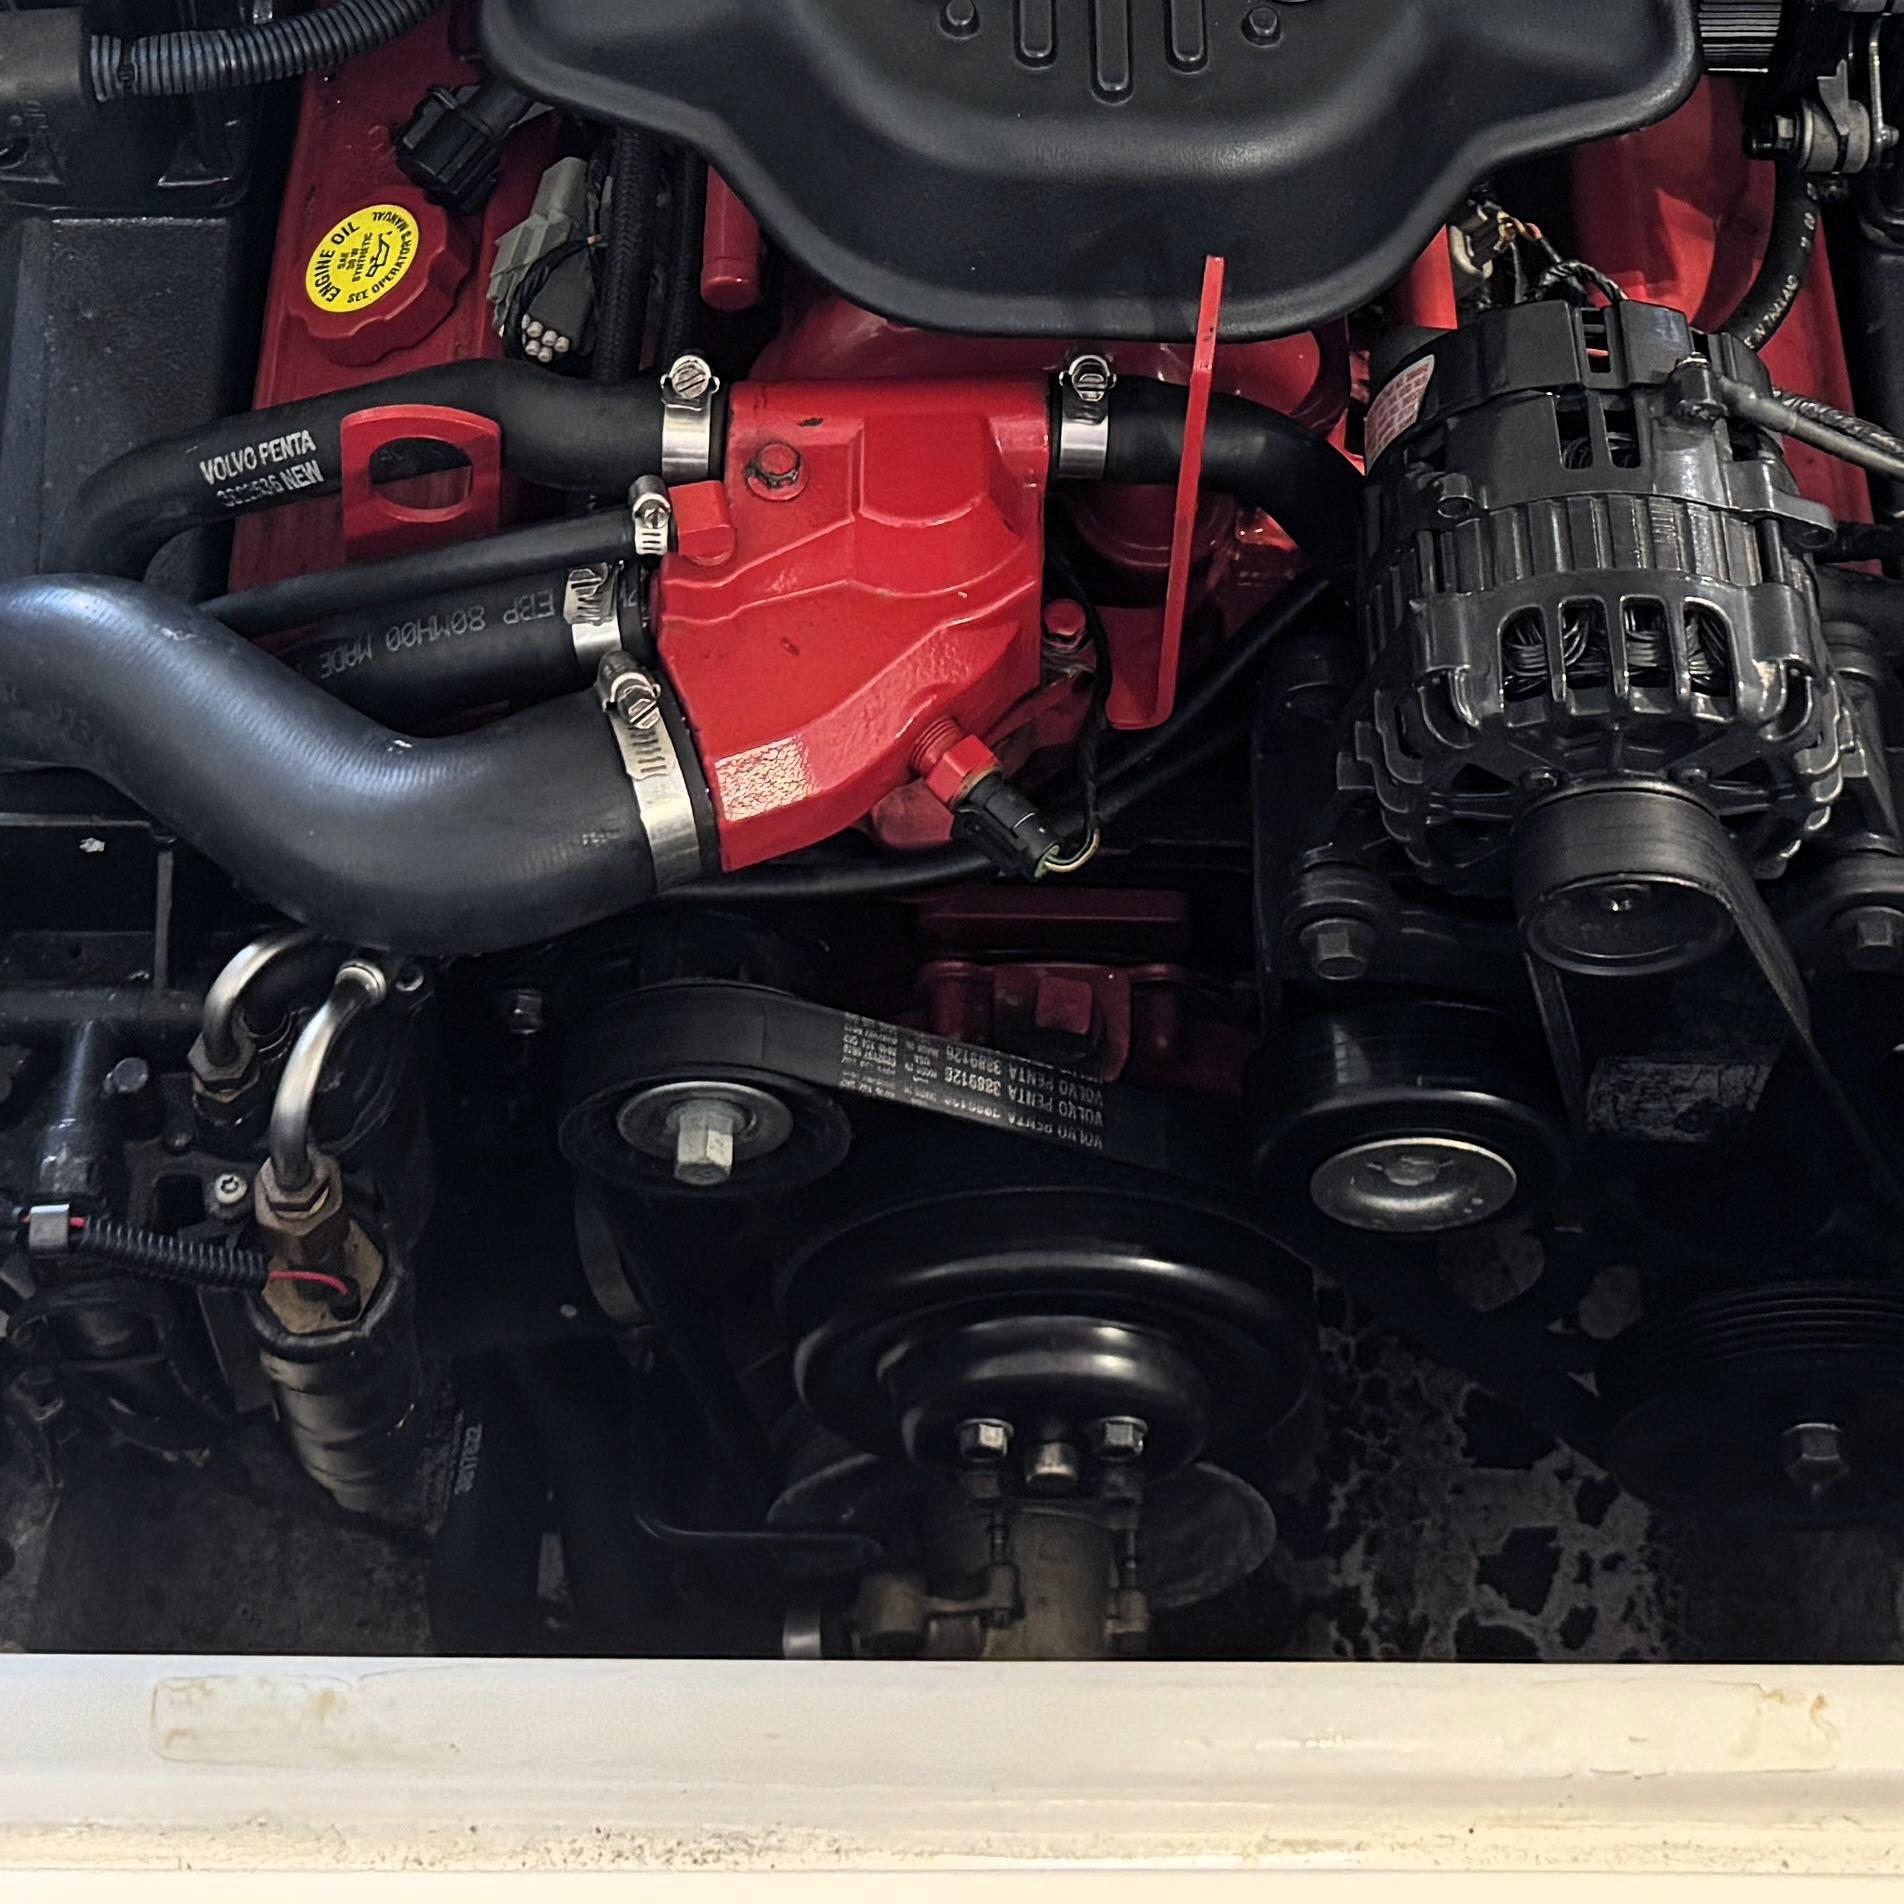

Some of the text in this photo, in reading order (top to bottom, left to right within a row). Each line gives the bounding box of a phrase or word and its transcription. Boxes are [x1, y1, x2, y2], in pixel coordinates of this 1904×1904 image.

[314, 221, 360, 303] ENGINE OIL
[346, 288, 369, 304] SEE
[198, 427, 320, 489] VOLVO PENTA
[280, 457, 325, 493] NEW
[1007, 1082, 1053, 1113] PENTA
[1057, 1098, 1103, 1128] VOLVO
